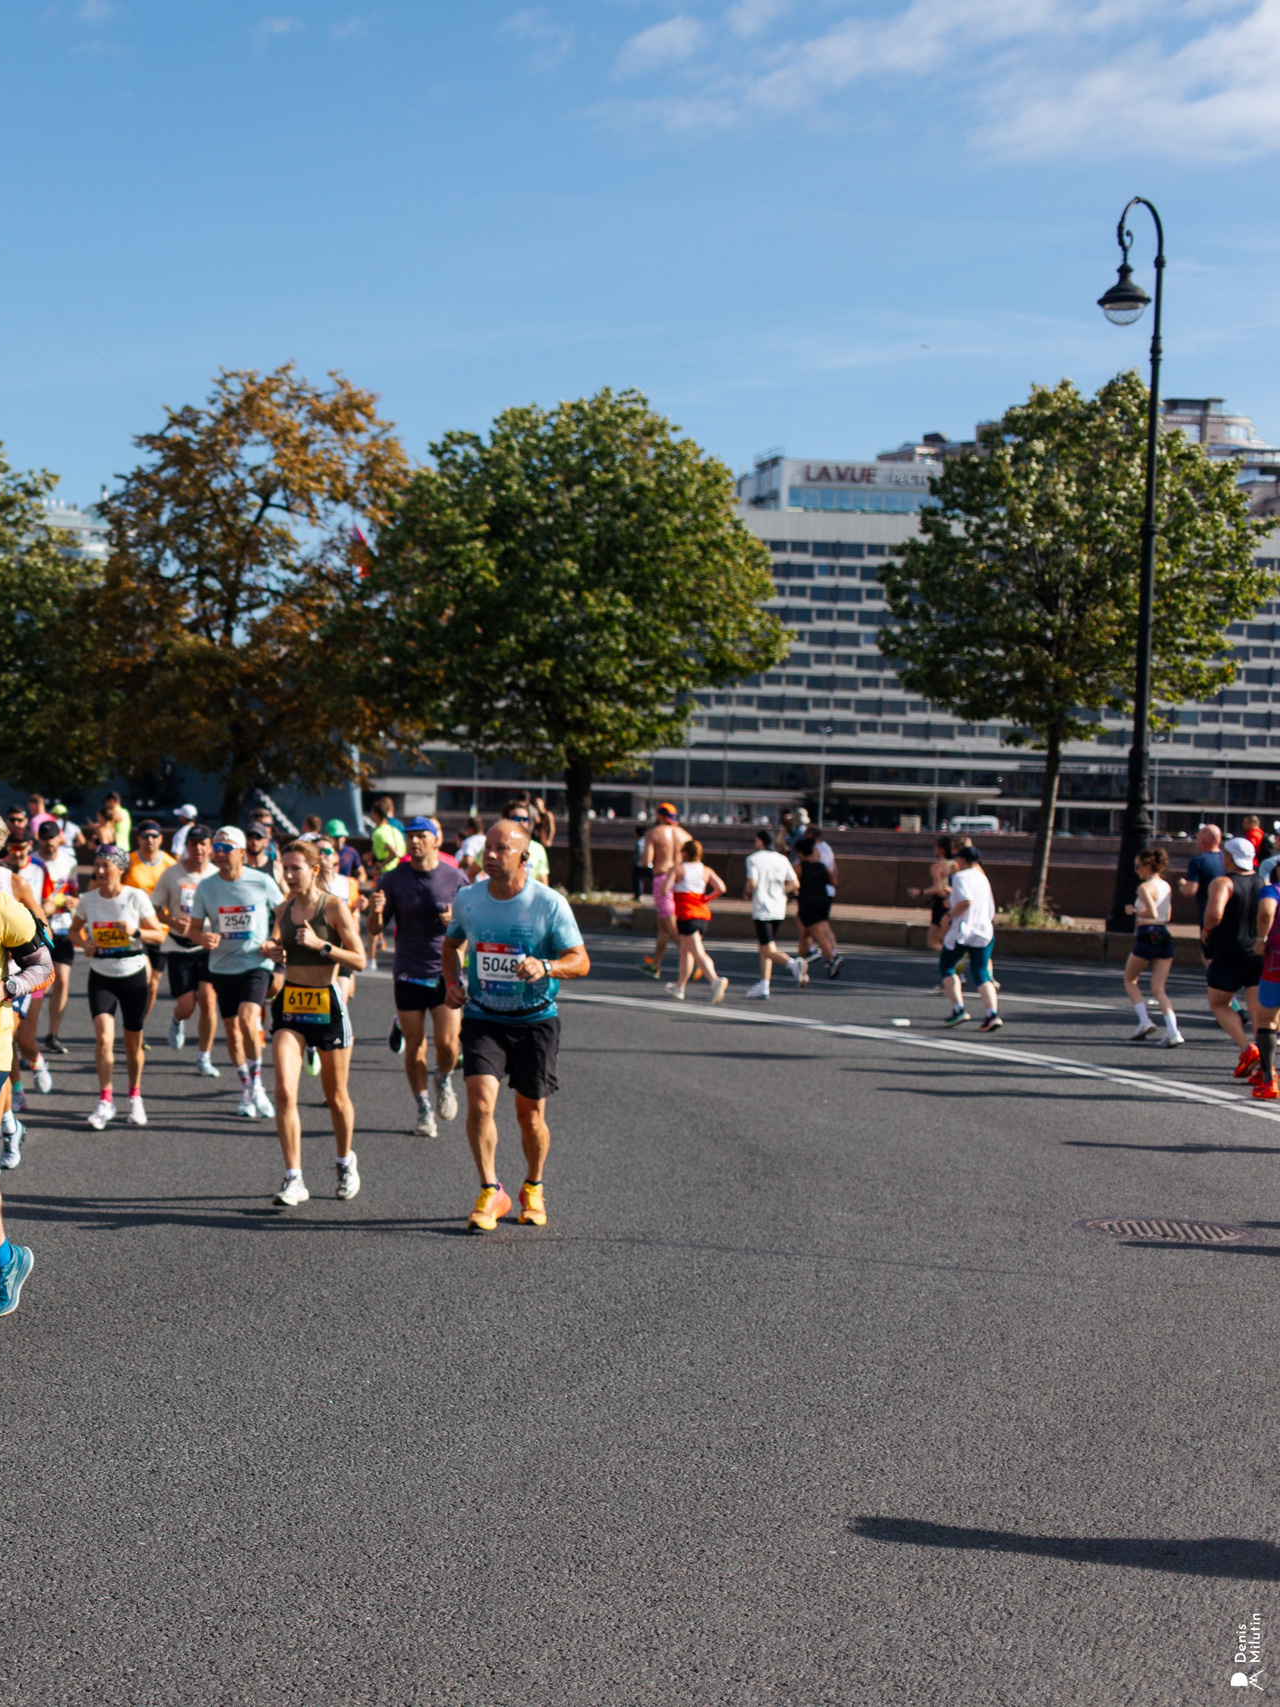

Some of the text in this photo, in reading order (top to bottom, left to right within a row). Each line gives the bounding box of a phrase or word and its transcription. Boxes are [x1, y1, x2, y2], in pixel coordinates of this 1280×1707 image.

[805, 465, 878, 484] LA VUE
[224, 914, 252, 927] 2547
[482, 956, 518, 973] 5048
[288, 991, 321, 1006] 6171
